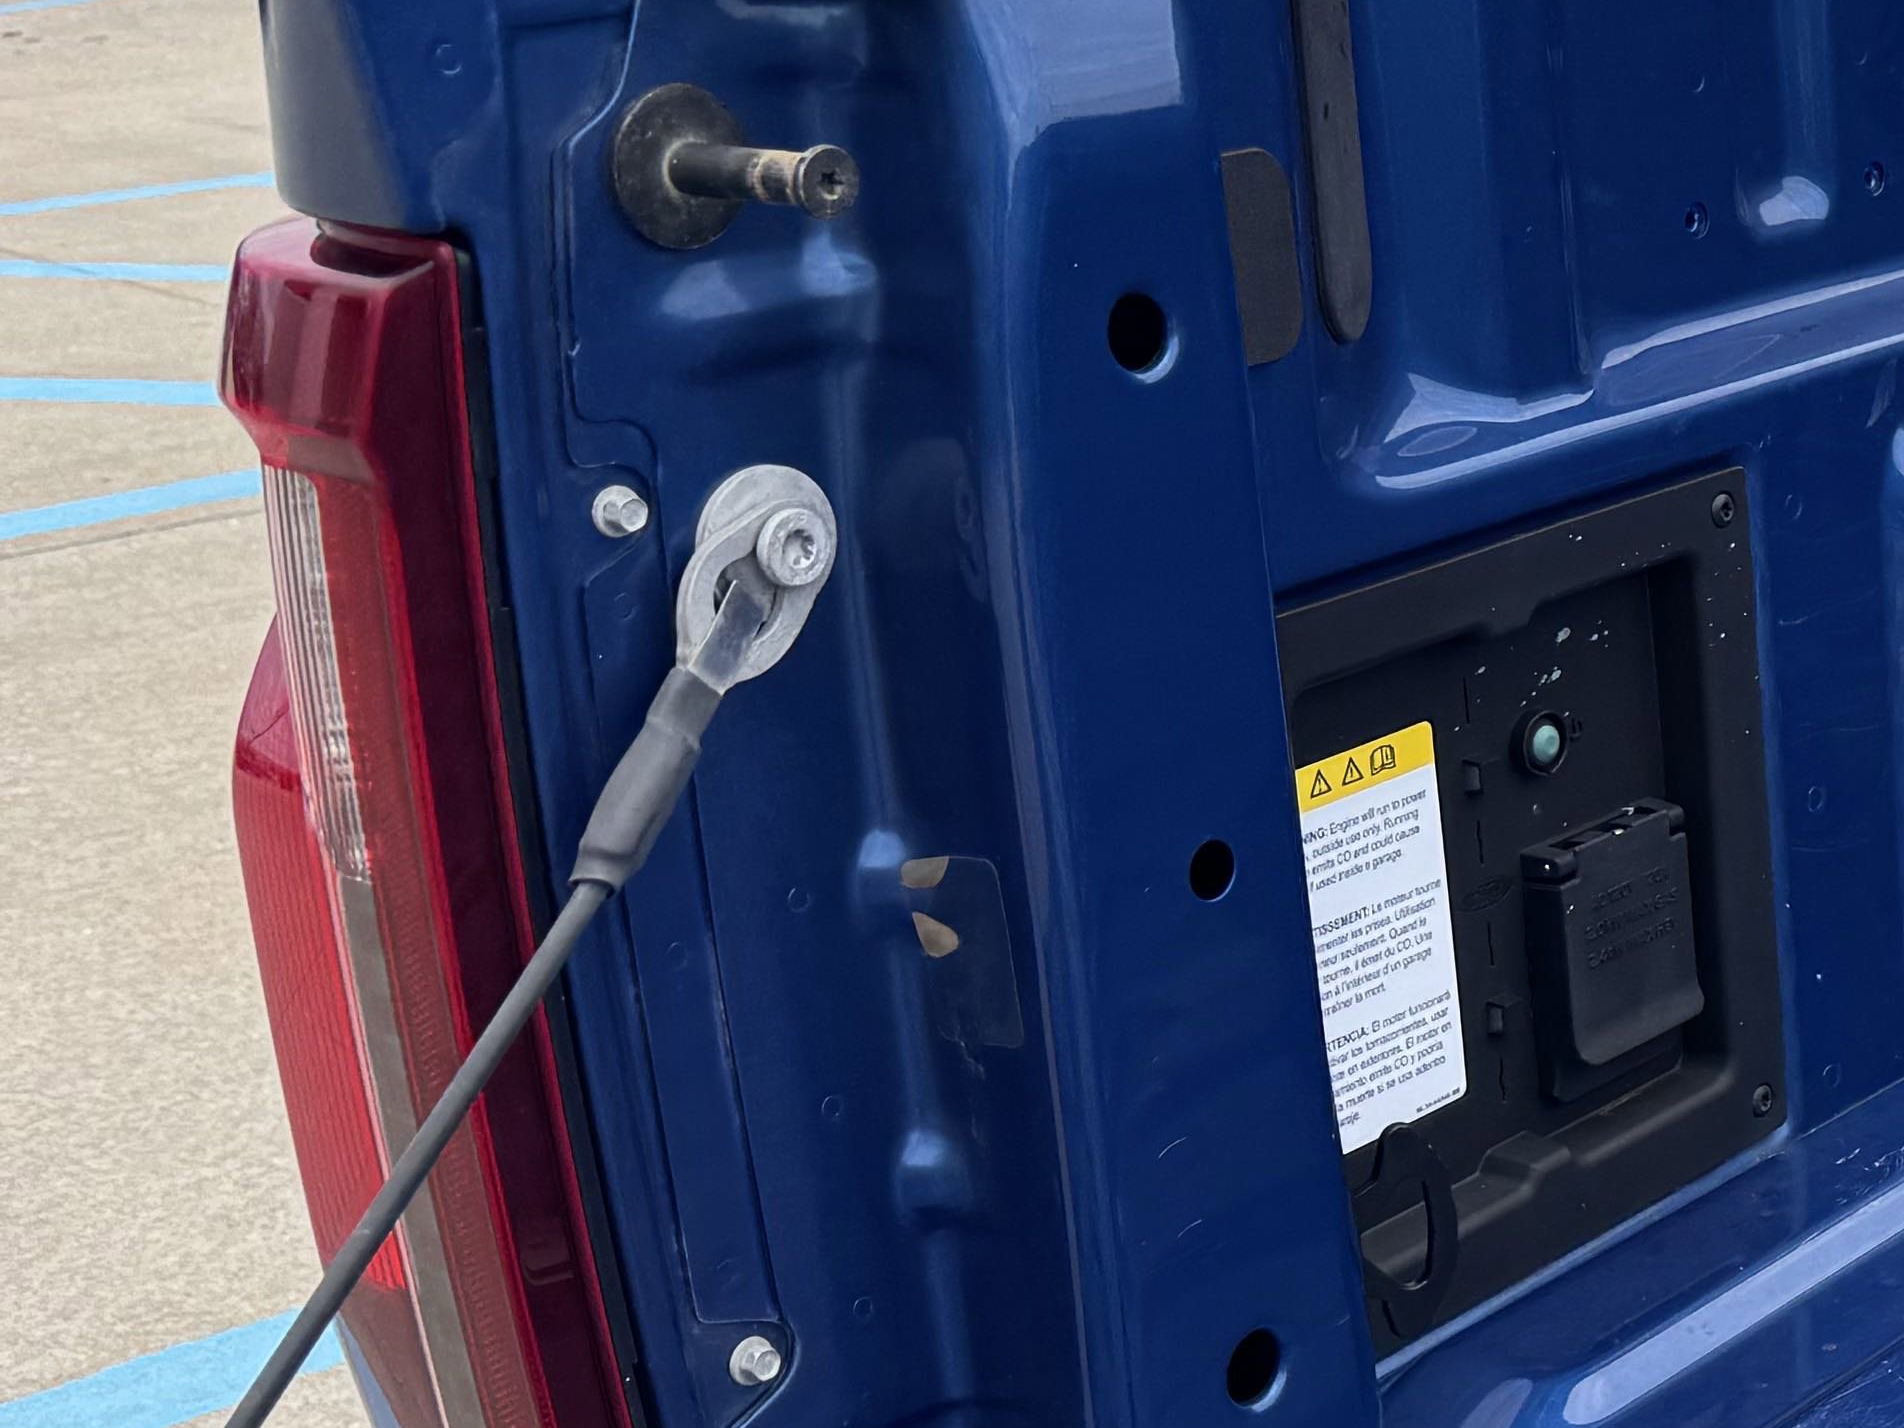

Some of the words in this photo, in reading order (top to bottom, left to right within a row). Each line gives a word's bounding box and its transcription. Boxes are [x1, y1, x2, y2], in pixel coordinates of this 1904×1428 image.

[1383, 808, 1419, 831] Running
[1336, 850, 1352, 865] CO
[1393, 1055, 1409, 1070] CO
